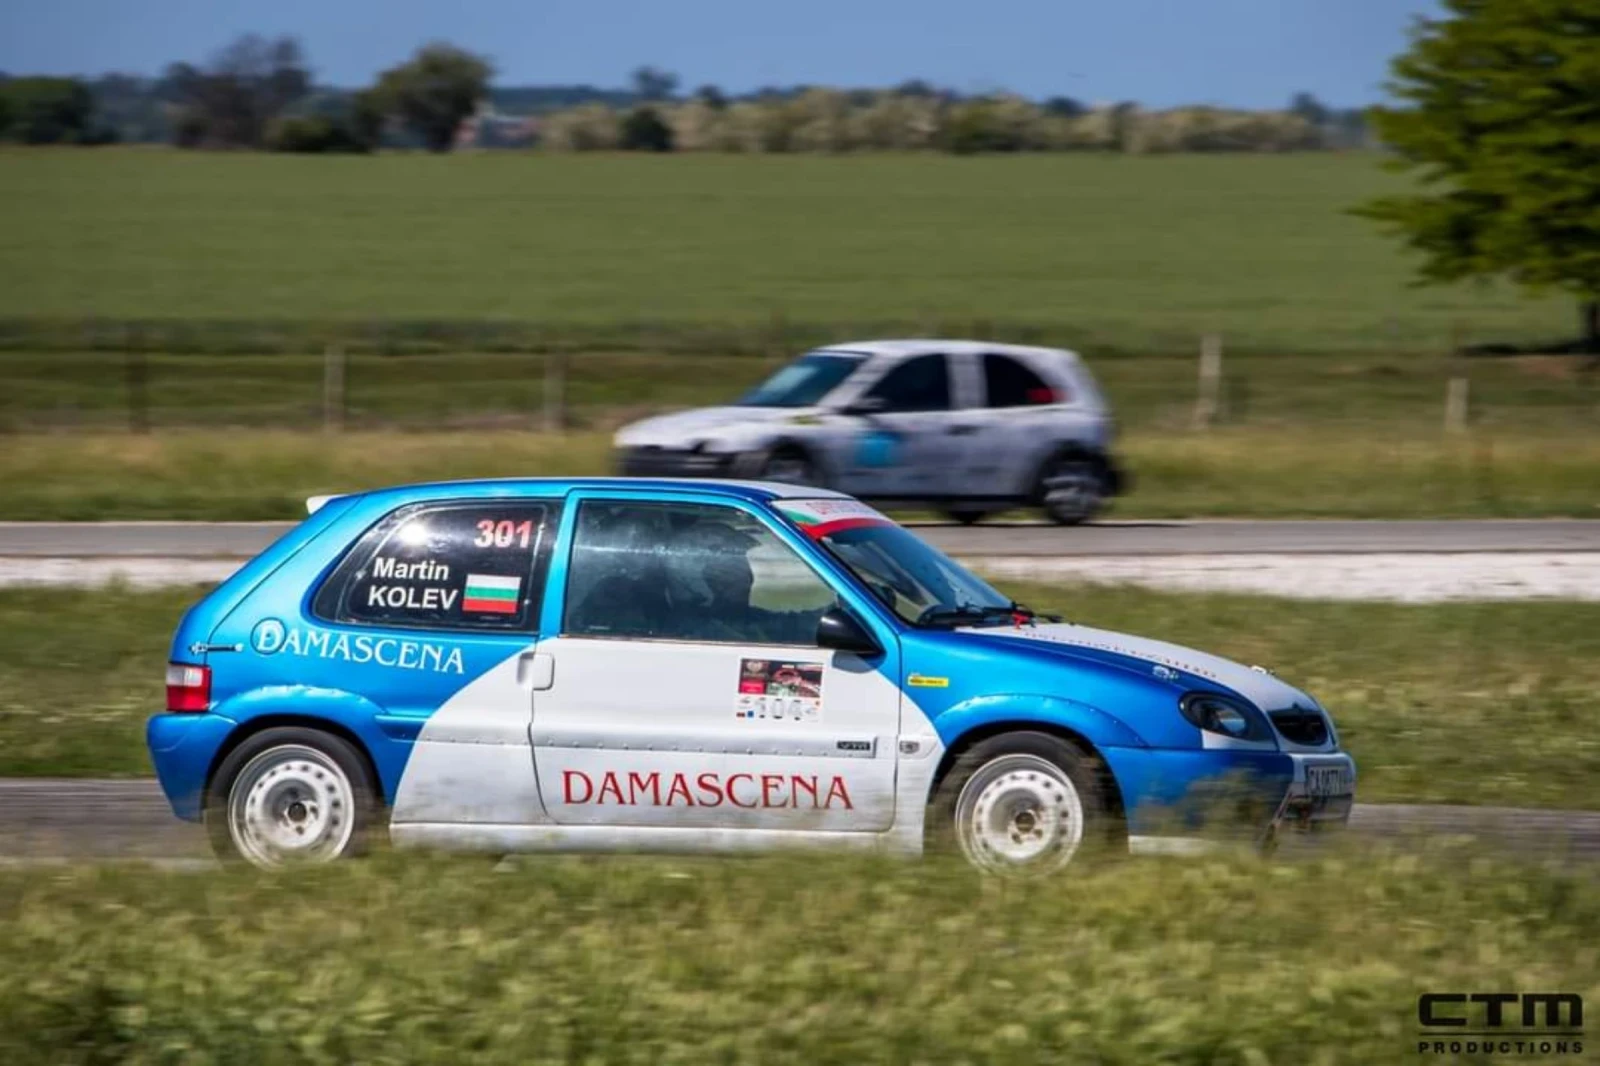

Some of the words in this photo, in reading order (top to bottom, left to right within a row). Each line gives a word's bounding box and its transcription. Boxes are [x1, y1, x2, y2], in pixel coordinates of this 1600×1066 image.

[474, 519, 533, 549] 301
[372, 557, 450, 581] Martin
[366, 586, 458, 611] KOLEV
[254, 619, 465, 675] DAMASCENA
[562, 770, 854, 810] DAMASCENA
